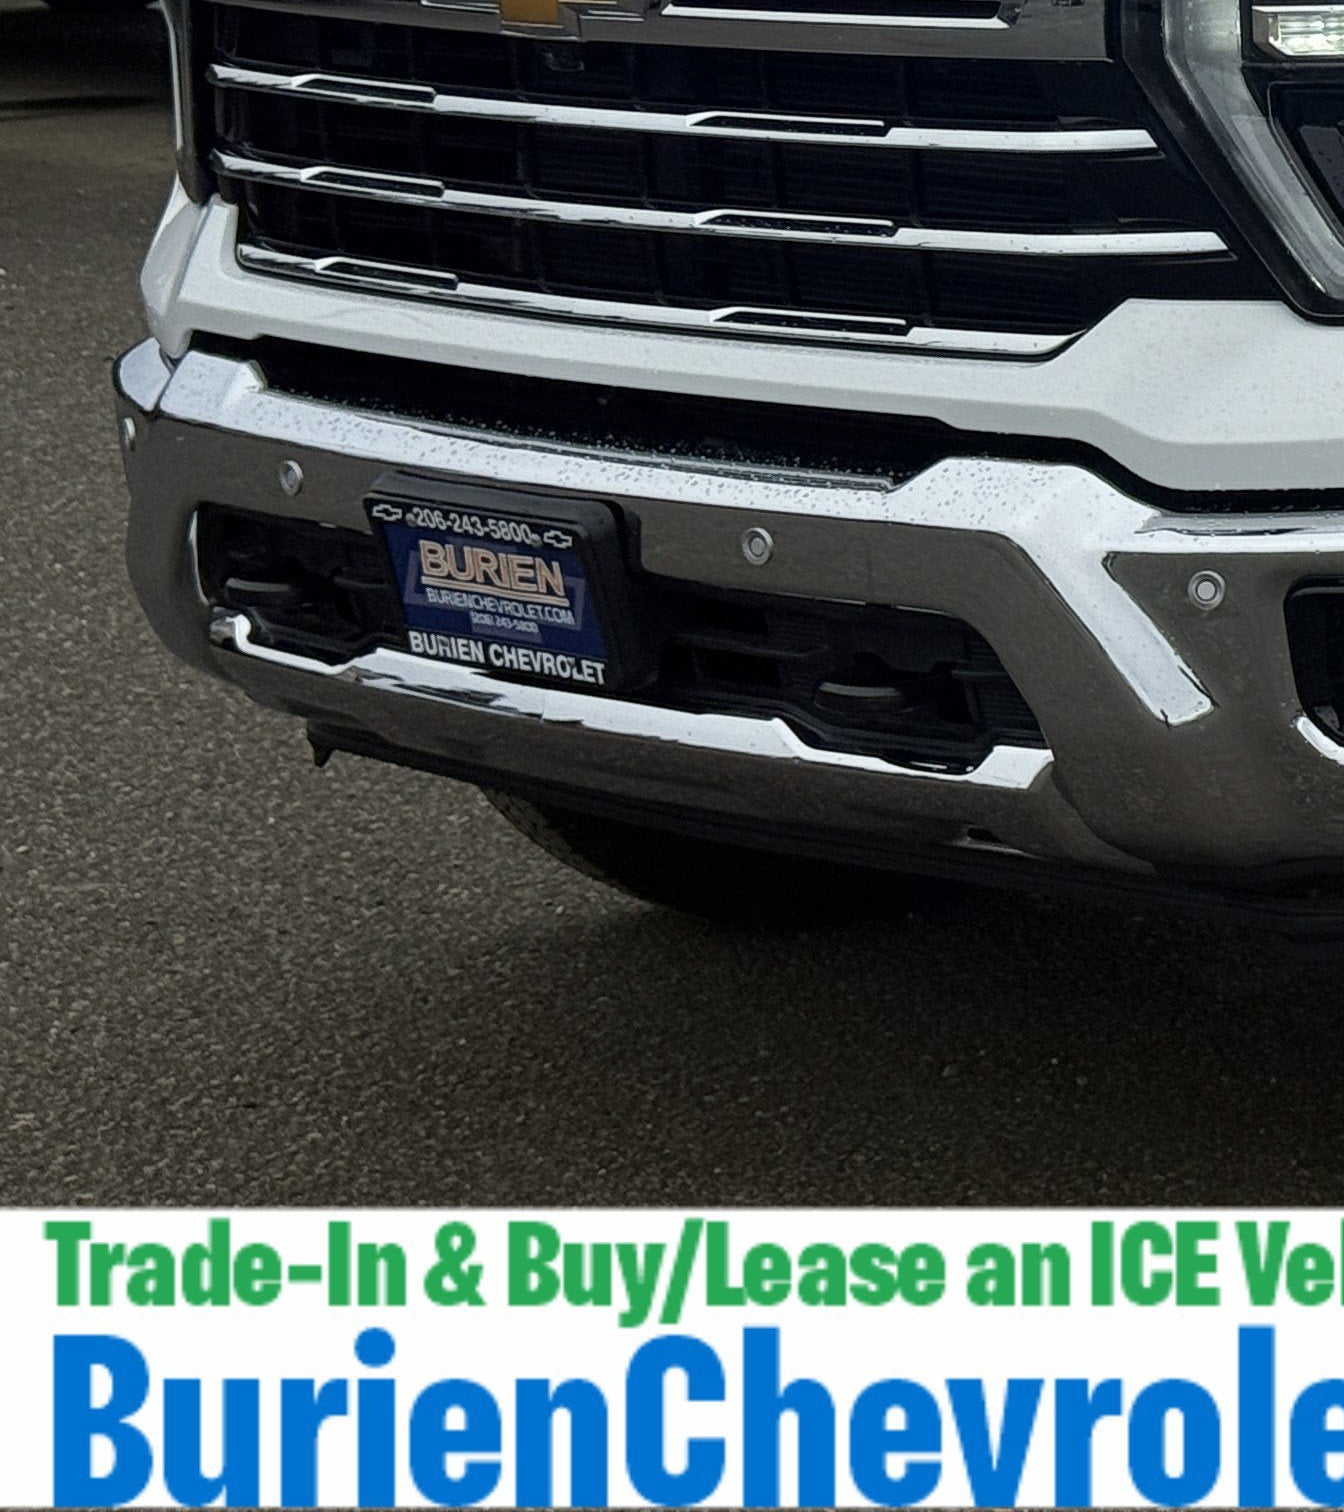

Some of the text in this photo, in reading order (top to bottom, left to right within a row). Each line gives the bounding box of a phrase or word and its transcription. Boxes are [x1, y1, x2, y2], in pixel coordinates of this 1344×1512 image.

[411, 506, 533, 546] 206-243-5800
[418, 538, 566, 598] BURIEN
[407, 630, 606, 686] BURIEN CHEVROLET
